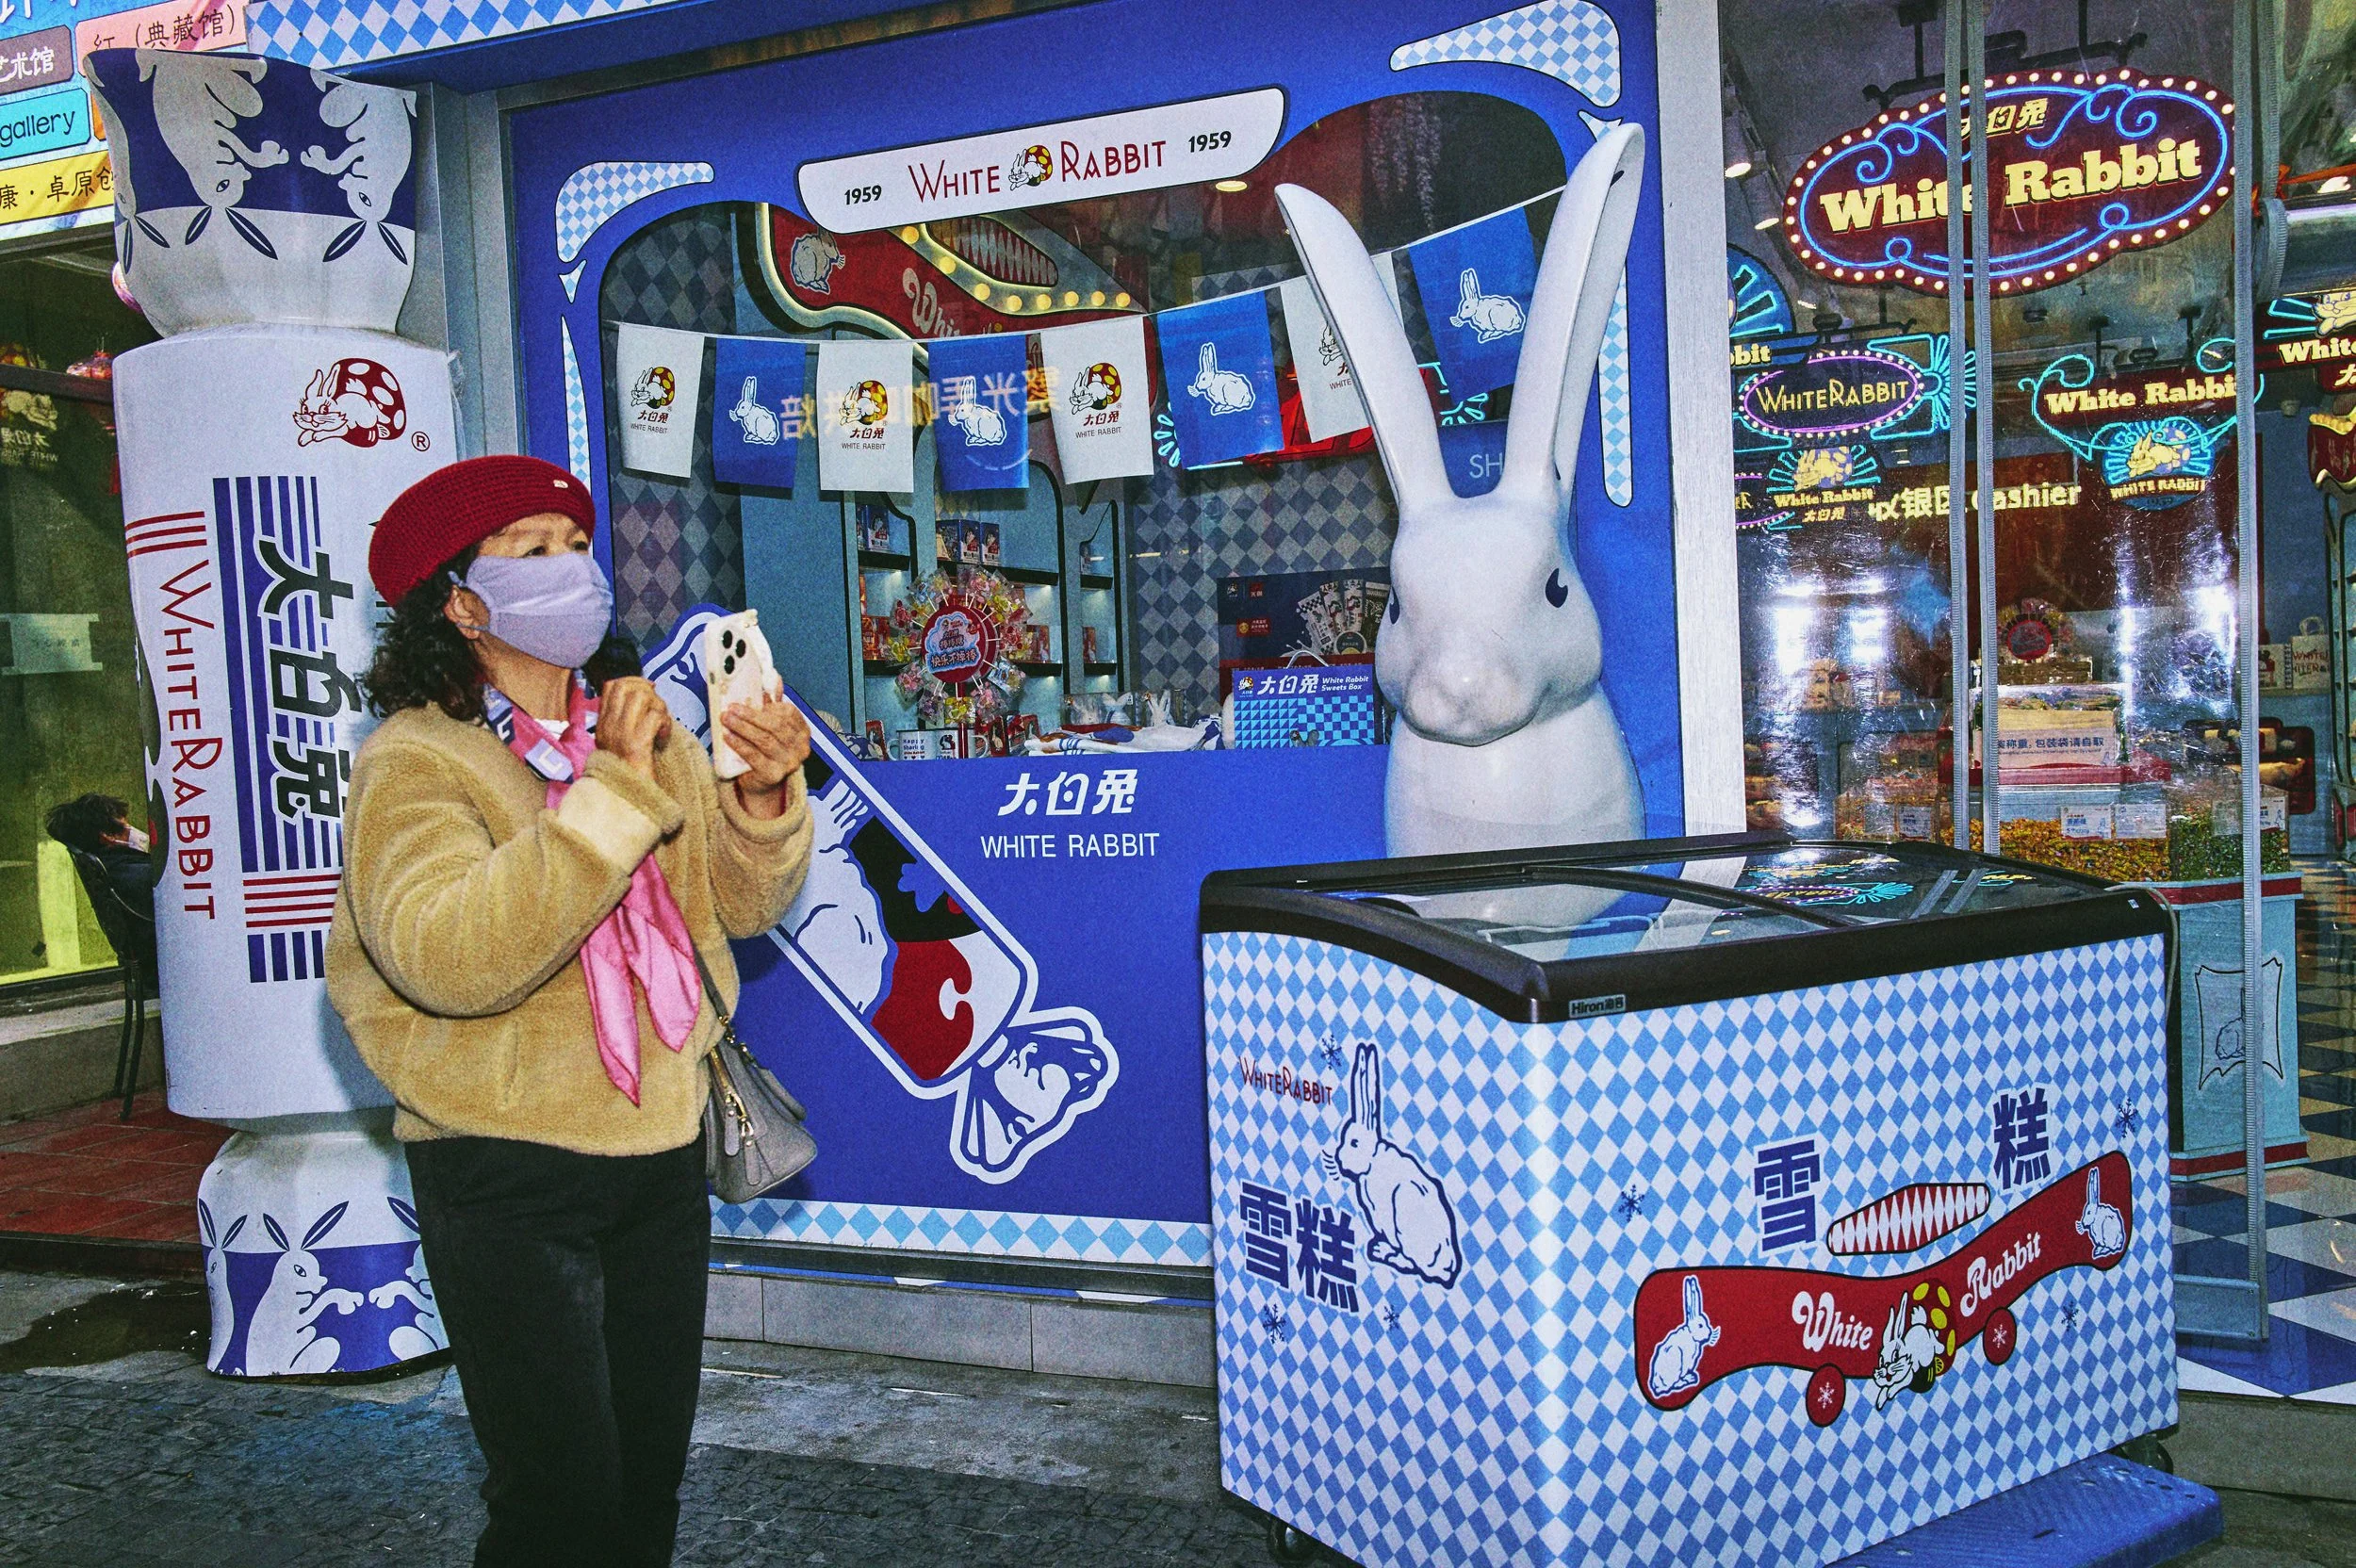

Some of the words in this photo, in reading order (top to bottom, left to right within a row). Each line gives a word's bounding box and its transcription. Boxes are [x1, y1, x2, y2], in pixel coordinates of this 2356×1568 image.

[1960, 98, 2048, 137] 白兔
[0, 111, 75, 147] gallery
[844, 186, 882, 205] 1959
[1187, 130, 1232, 154] 1959
[2004, 138, 2203, 206] Rabbit
[1330, 379, 1352, 390] WHITE
[2044, 389, 2136, 415] White
[2145, 375, 2238, 406] Rabbi
[638, 410, 669, 424] 大白兔
[1083, 410, 1120, 426] 大白兔
[647, 425, 668, 433] RABBIT
[849, 427, 885, 439] 大白兔
[1075, 430, 1096, 438] WHITE
[1097, 426, 1121, 435] RABBIT
[862, 442, 886, 450] RABBIT
[1774, 494, 1820, 508] White
[1821, 487, 1873, 503] Rabbit
[1257, 674, 1319, 695] 大白兔
[997, 769, 1138, 816] 大白兔
[980, 834, 1056, 858] WHITE
[1068, 832, 1160, 858] RABBIT
[1572, 1001, 1604, 1016] Hiron
[1239, 1181, 1360, 1313] 雪糕
[1791, 1290, 1873, 1352] White
[1960, 1231, 2041, 1317] Rabbit
